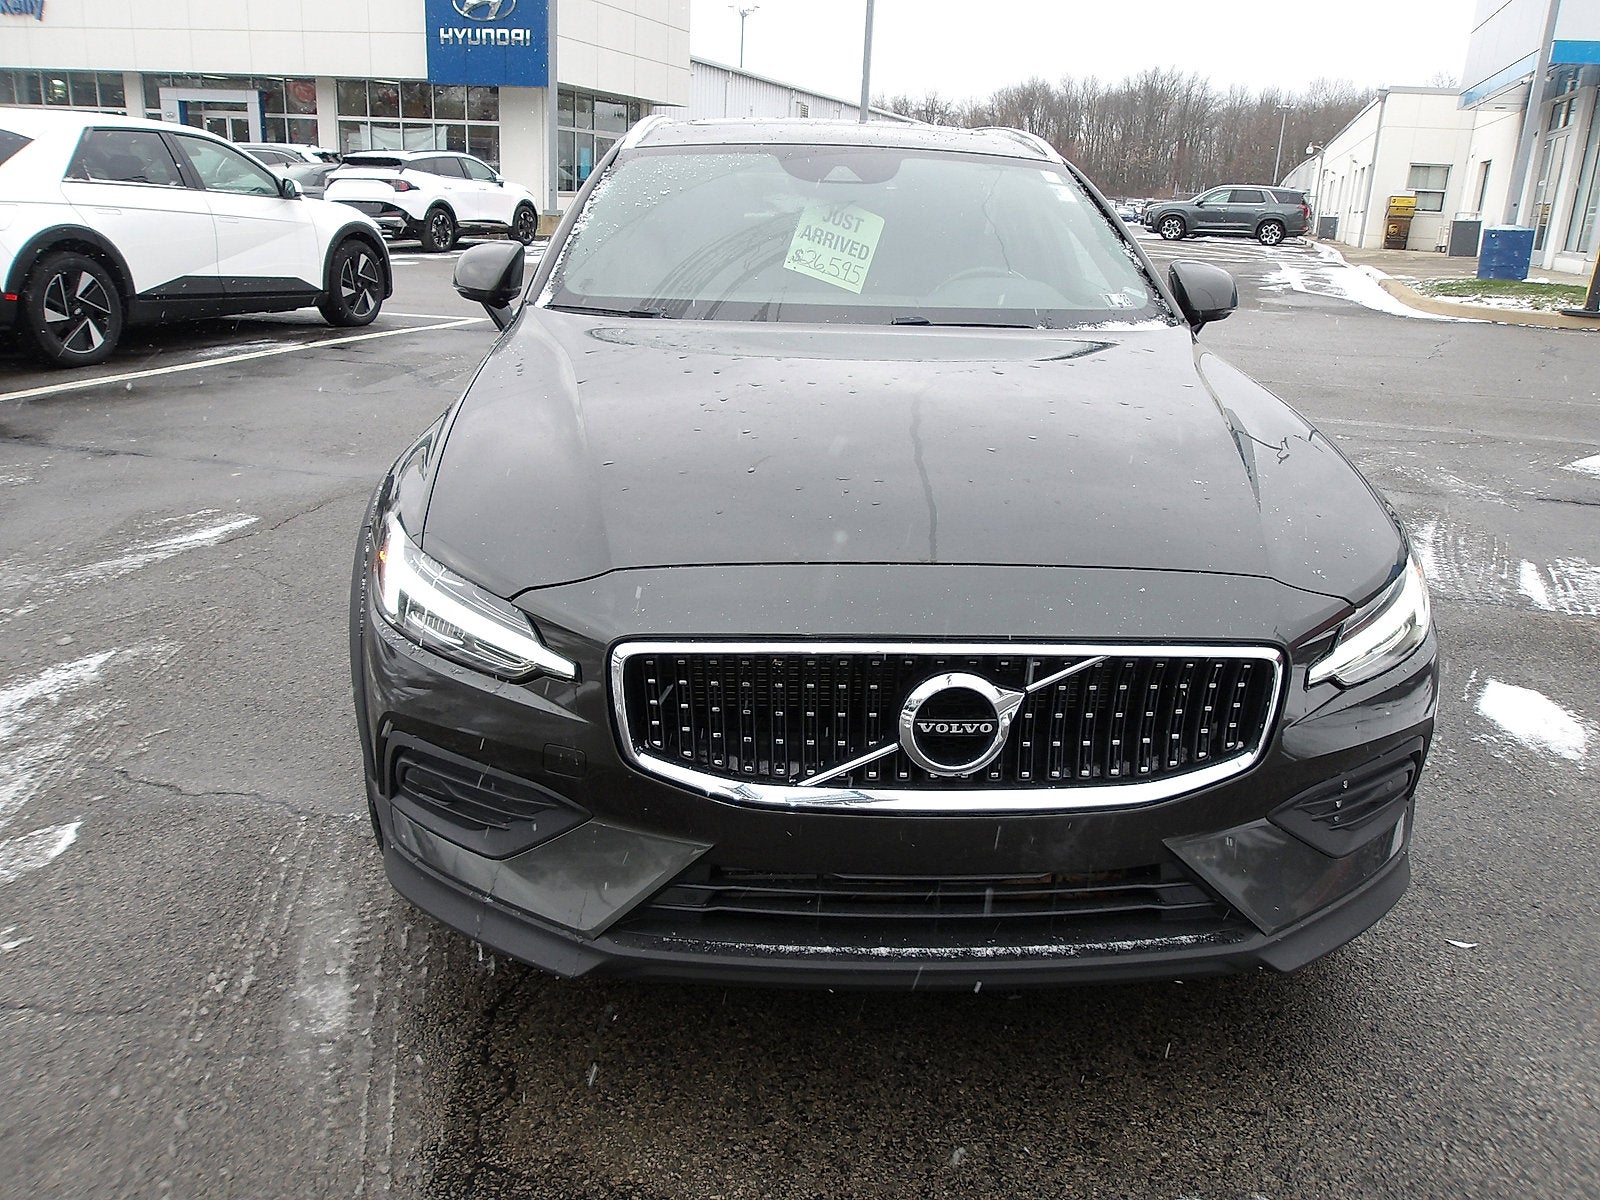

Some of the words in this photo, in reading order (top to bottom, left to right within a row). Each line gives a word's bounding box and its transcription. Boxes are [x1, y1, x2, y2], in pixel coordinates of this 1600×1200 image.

[440, 27, 531, 46] HYUNDAI
[822, 208, 864, 233] JUST
[800, 225, 870, 260] ARRIVED
[791, 248, 864, 285] $26,595
[917, 722, 993, 734] VOLVO
